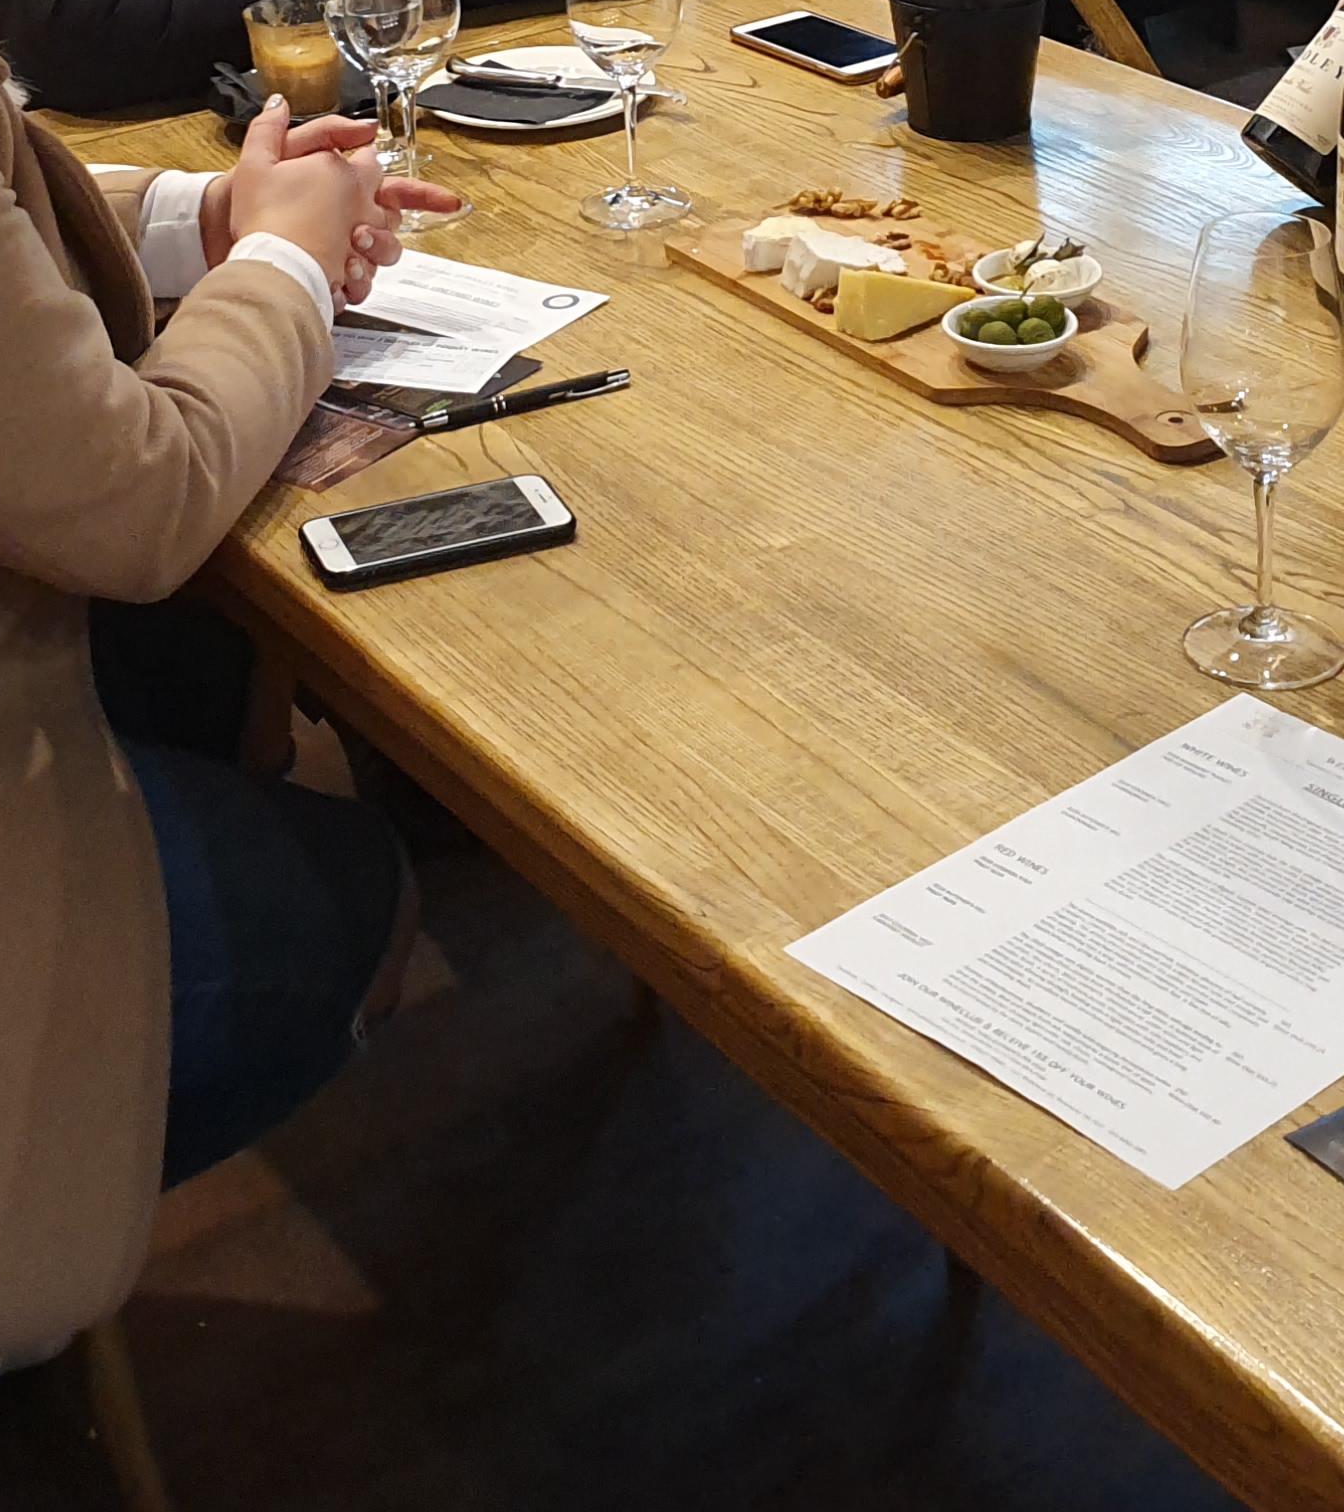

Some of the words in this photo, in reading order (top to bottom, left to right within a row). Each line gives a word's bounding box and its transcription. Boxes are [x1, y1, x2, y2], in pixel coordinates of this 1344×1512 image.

[1178, 742, 1216, 761] WHITE
[1212, 758, 1250, 777] WINES
[992, 843, 1018, 857] RED
[1014, 855, 1050, 875] WINES
